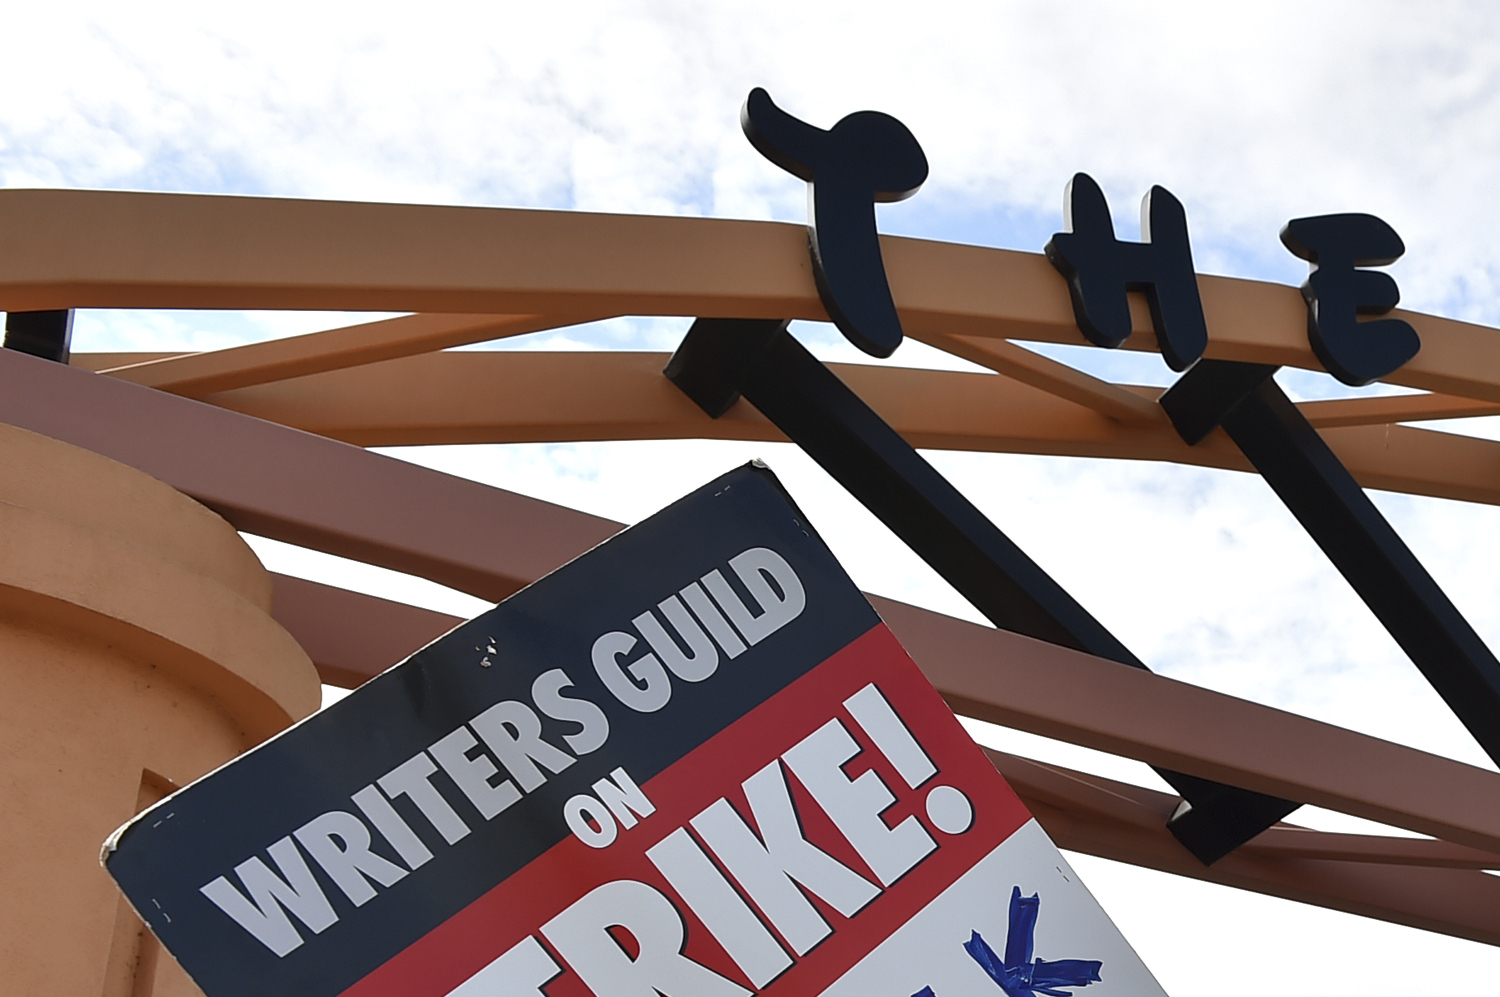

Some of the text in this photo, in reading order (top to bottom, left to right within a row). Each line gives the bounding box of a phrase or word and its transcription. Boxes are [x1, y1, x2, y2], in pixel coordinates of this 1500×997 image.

[741, 87, 1421, 387] THE
[199, 547, 807, 959] WRITERS GUILD
[563, 766, 657, 850] ON
